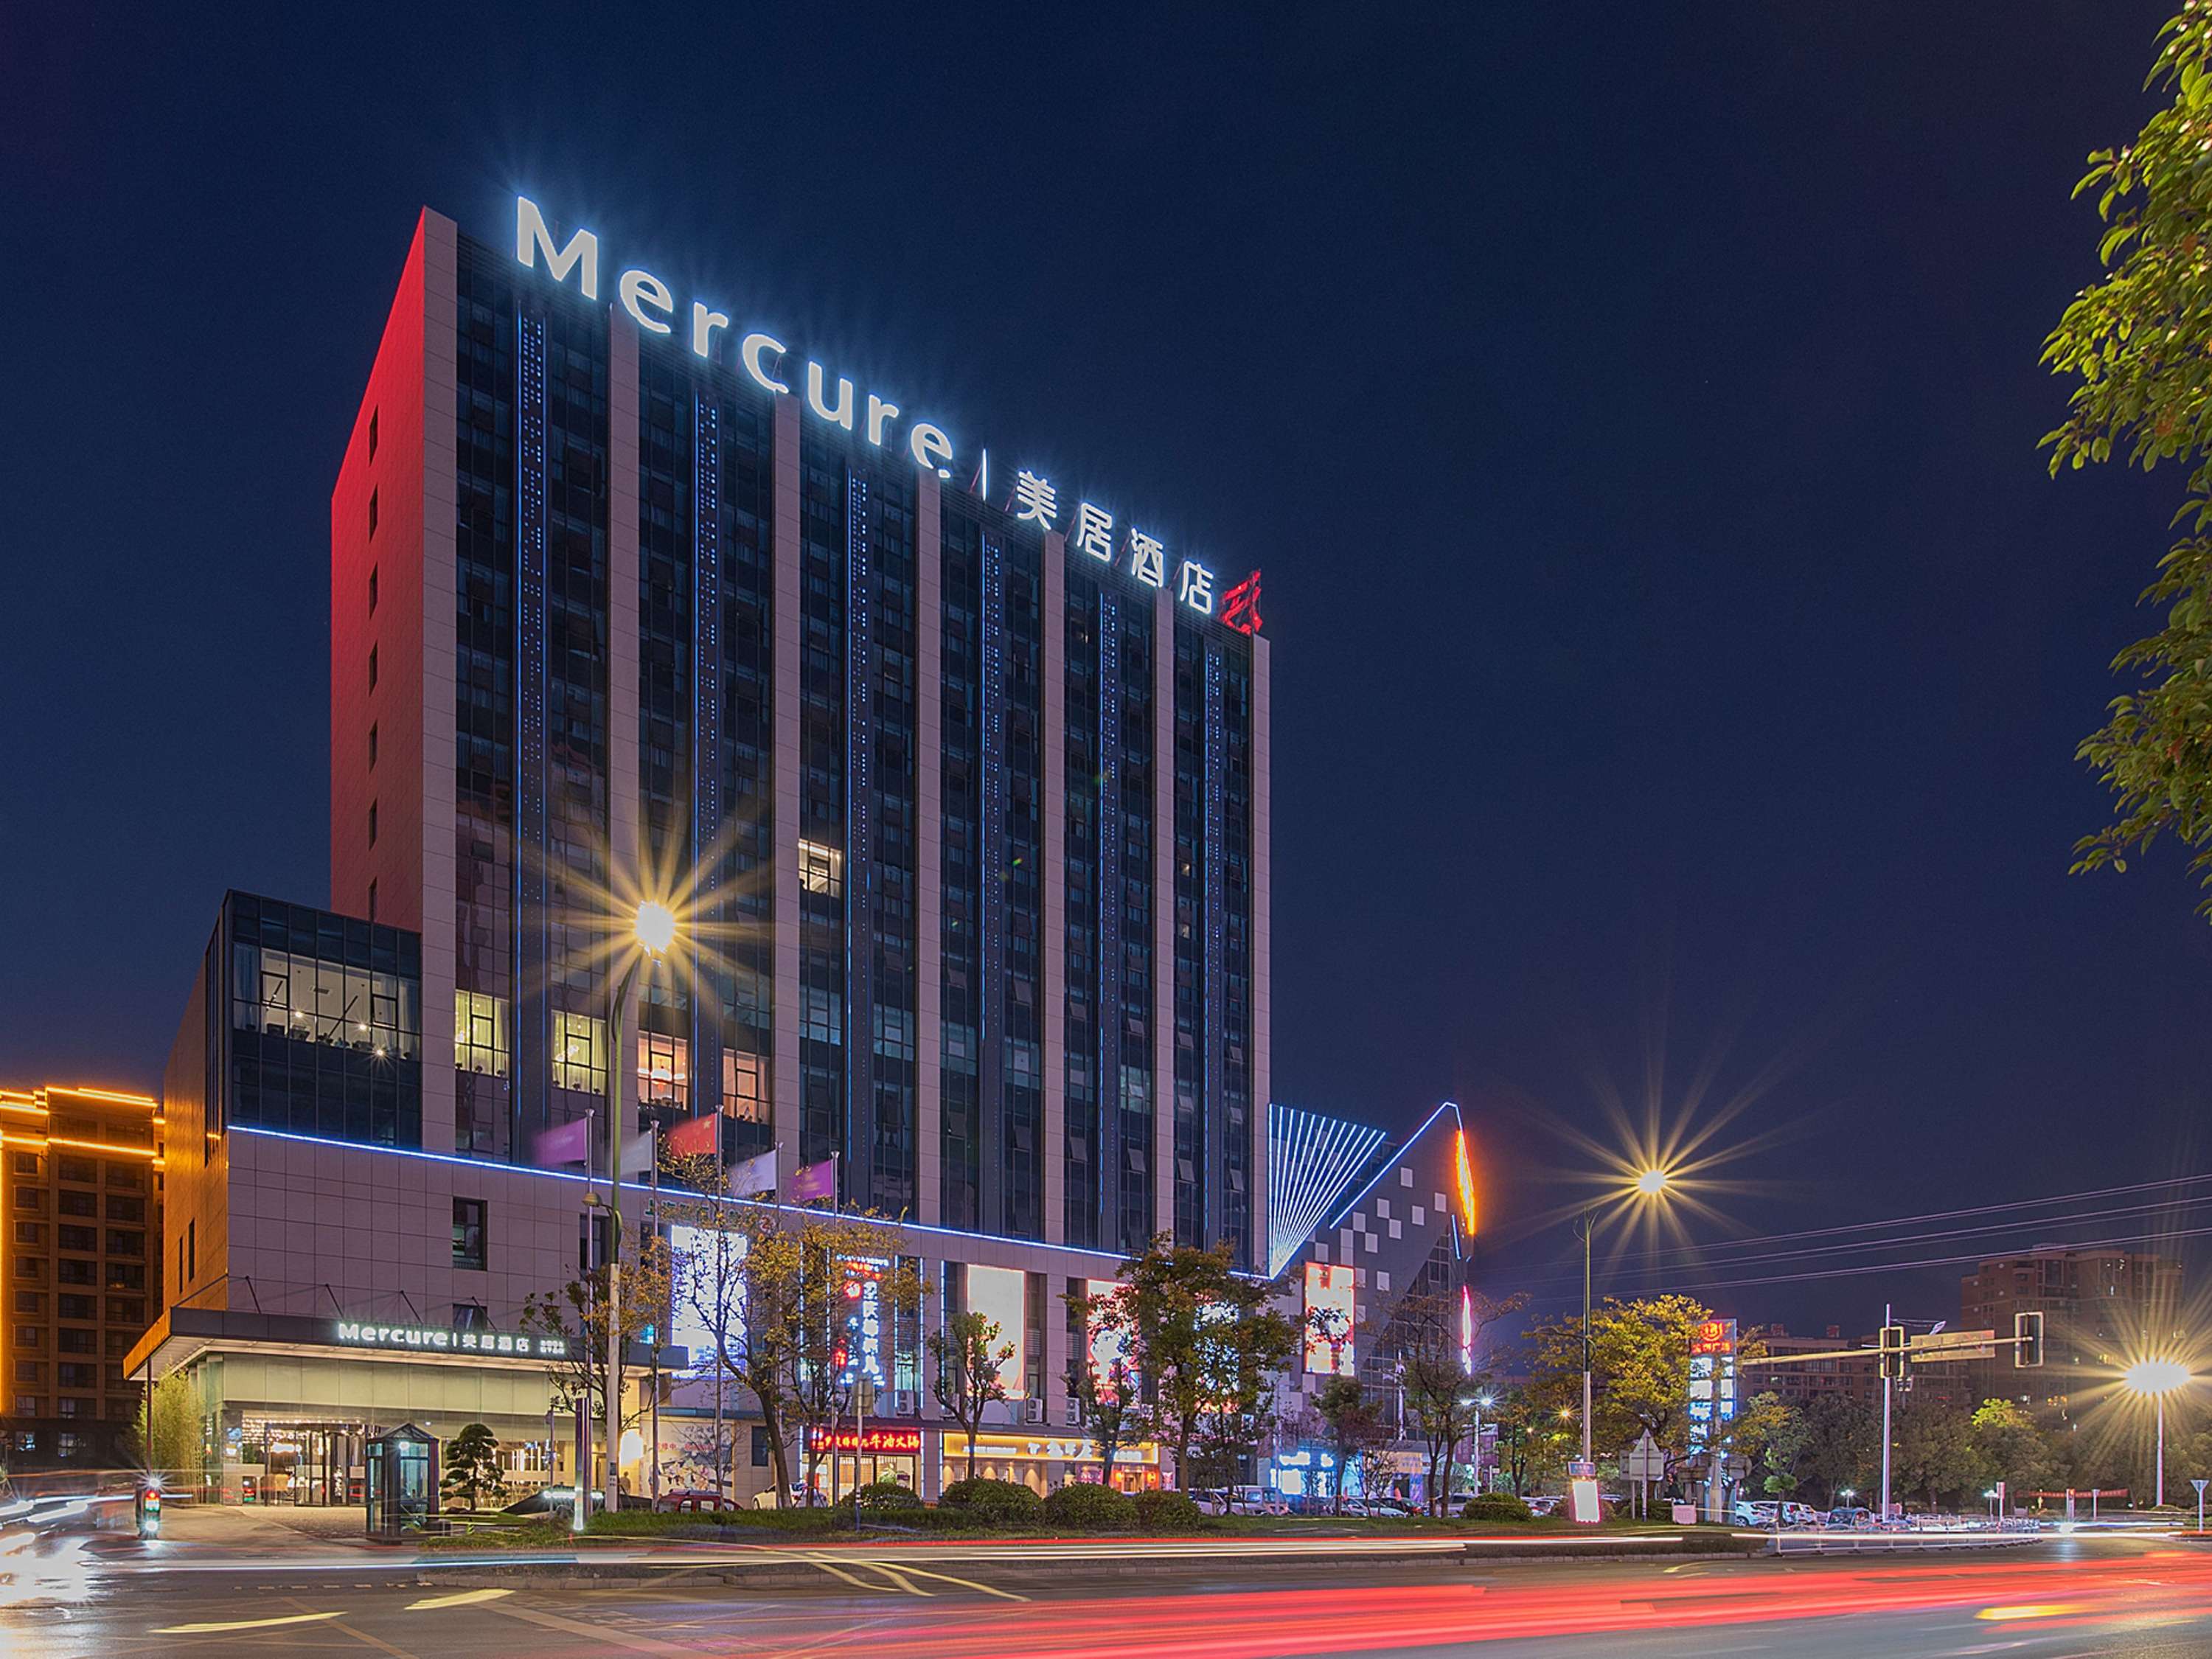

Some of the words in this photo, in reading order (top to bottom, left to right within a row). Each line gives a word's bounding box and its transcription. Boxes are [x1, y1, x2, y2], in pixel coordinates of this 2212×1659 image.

[517, 195, 953, 479] Mercure
[1017, 470, 1214, 613] 美居酒店
[338, 1324, 448, 1346] Mercure
